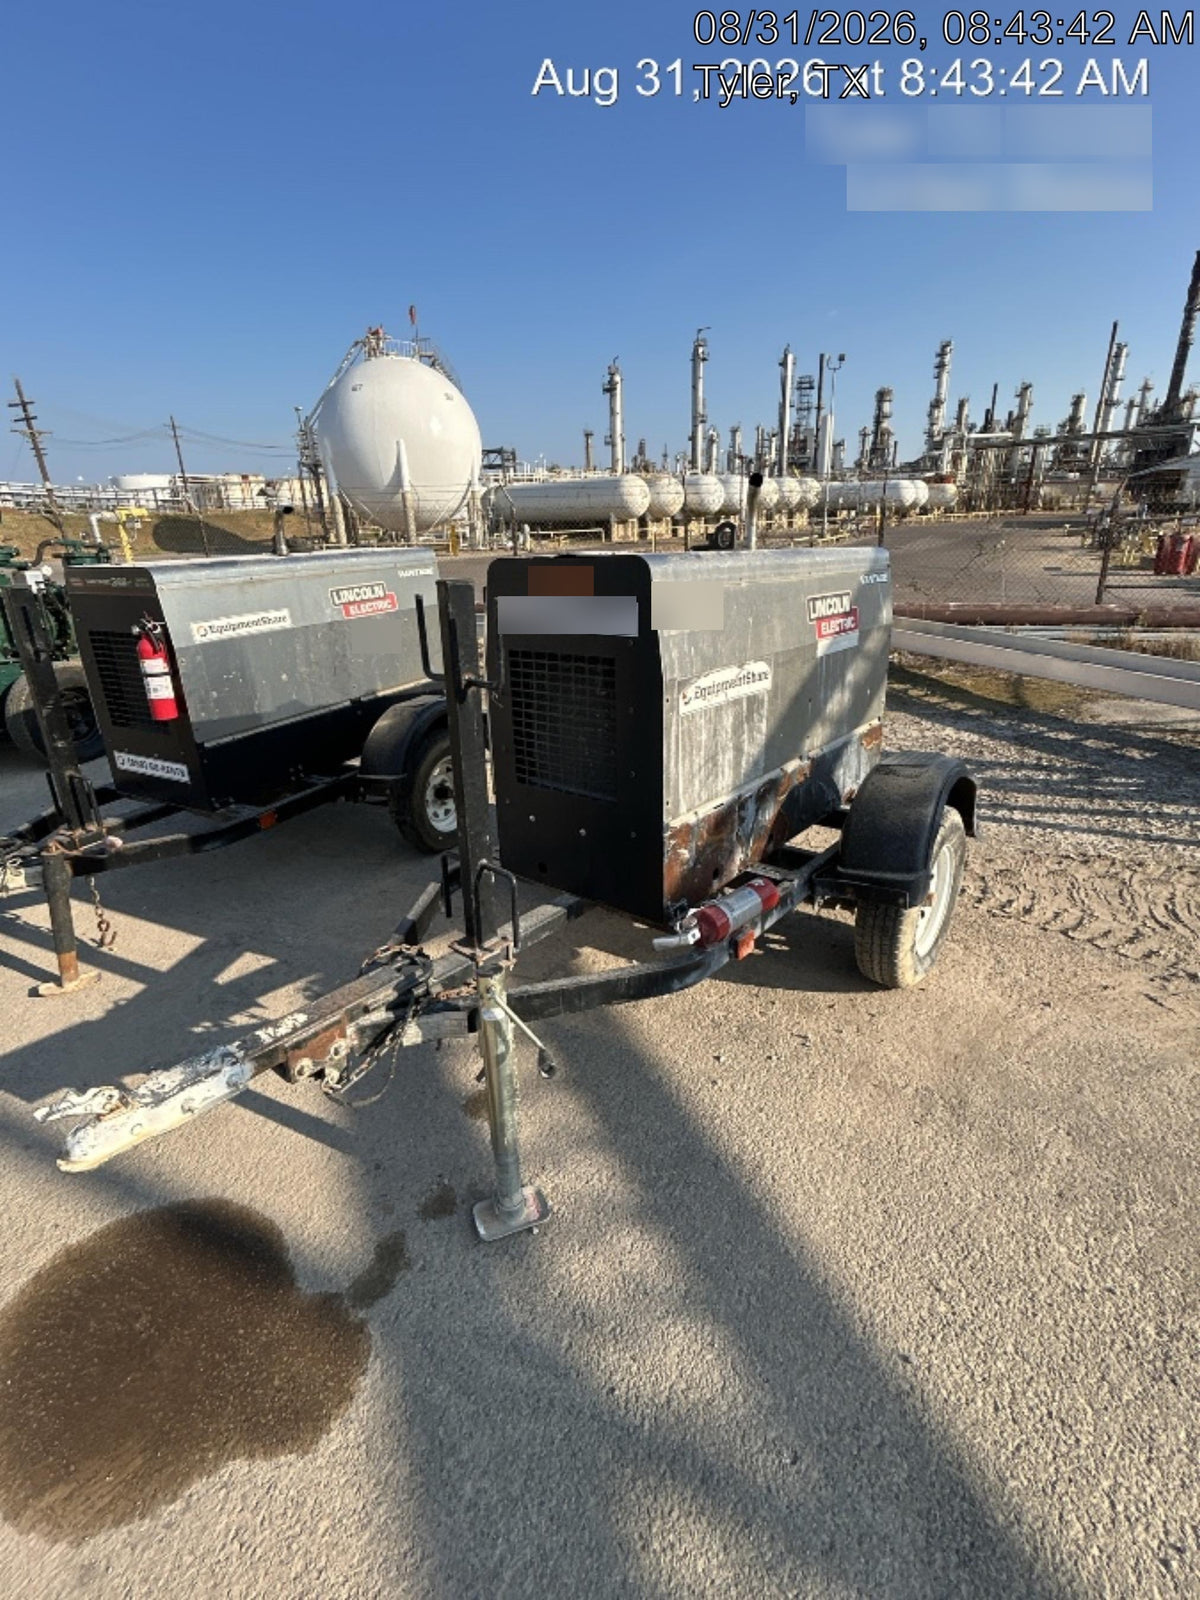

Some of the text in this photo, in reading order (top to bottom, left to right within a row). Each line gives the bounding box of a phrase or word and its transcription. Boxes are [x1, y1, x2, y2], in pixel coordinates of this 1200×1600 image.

[332, 584, 384, 604] LINCOLN
[349, 600, 393, 614] ELECTRIC
[809, 595, 850, 619] LINCOLN
[821, 616, 856, 635] ELECTRIC
